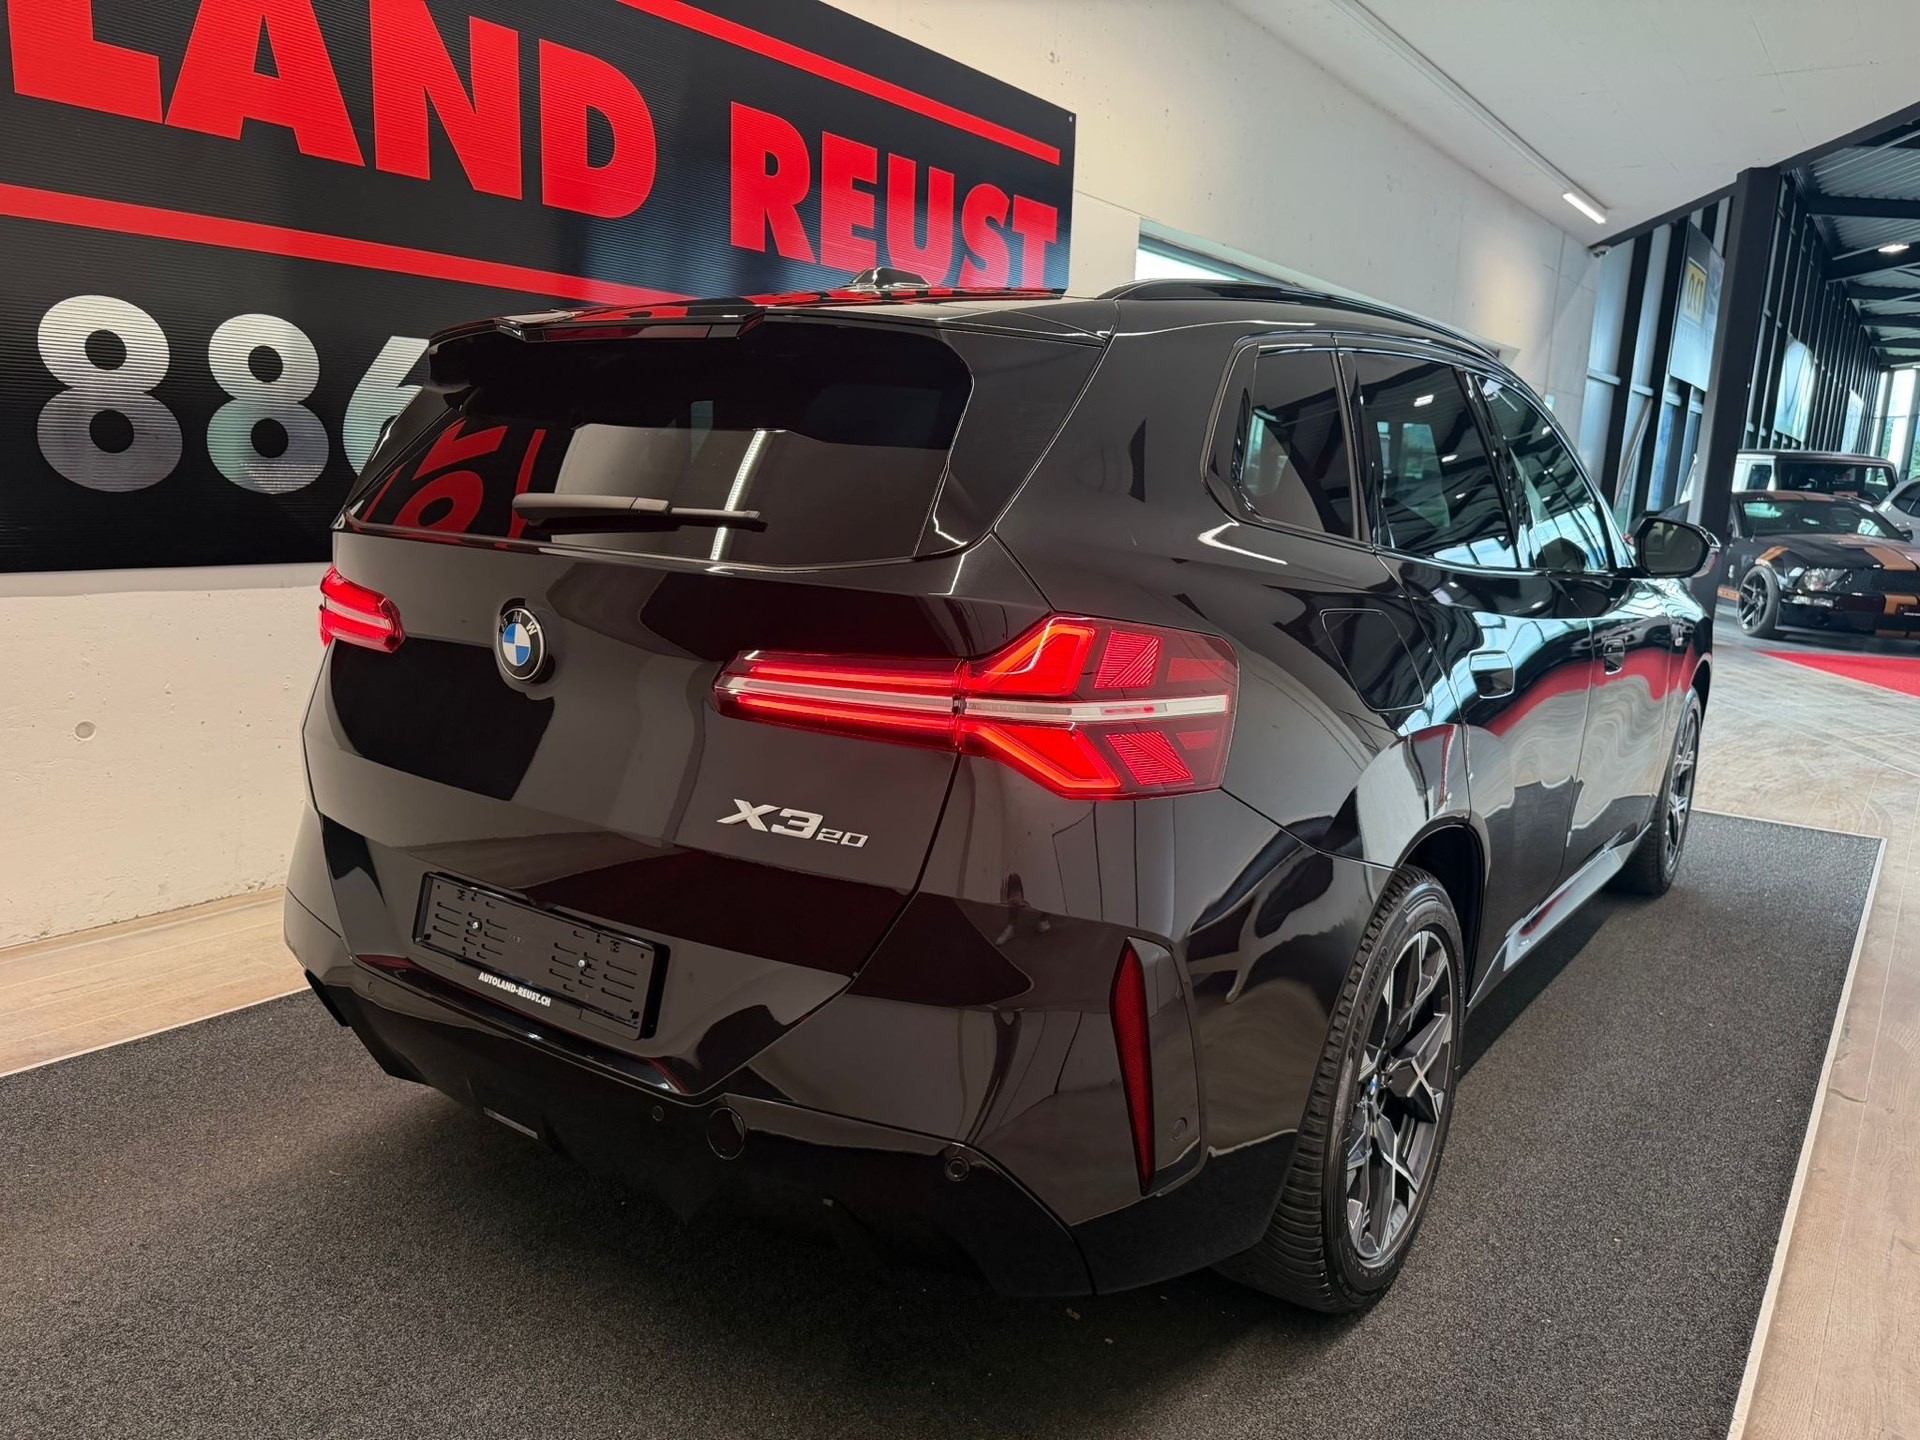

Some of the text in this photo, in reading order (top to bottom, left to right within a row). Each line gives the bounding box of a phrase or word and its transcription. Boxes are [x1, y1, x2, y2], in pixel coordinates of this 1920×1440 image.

[731, 101, 1057, 288] REUST
[499, 611, 538, 636] BMW
[478, 972, 551, 1007] AUTOLAND-REUST.CH
